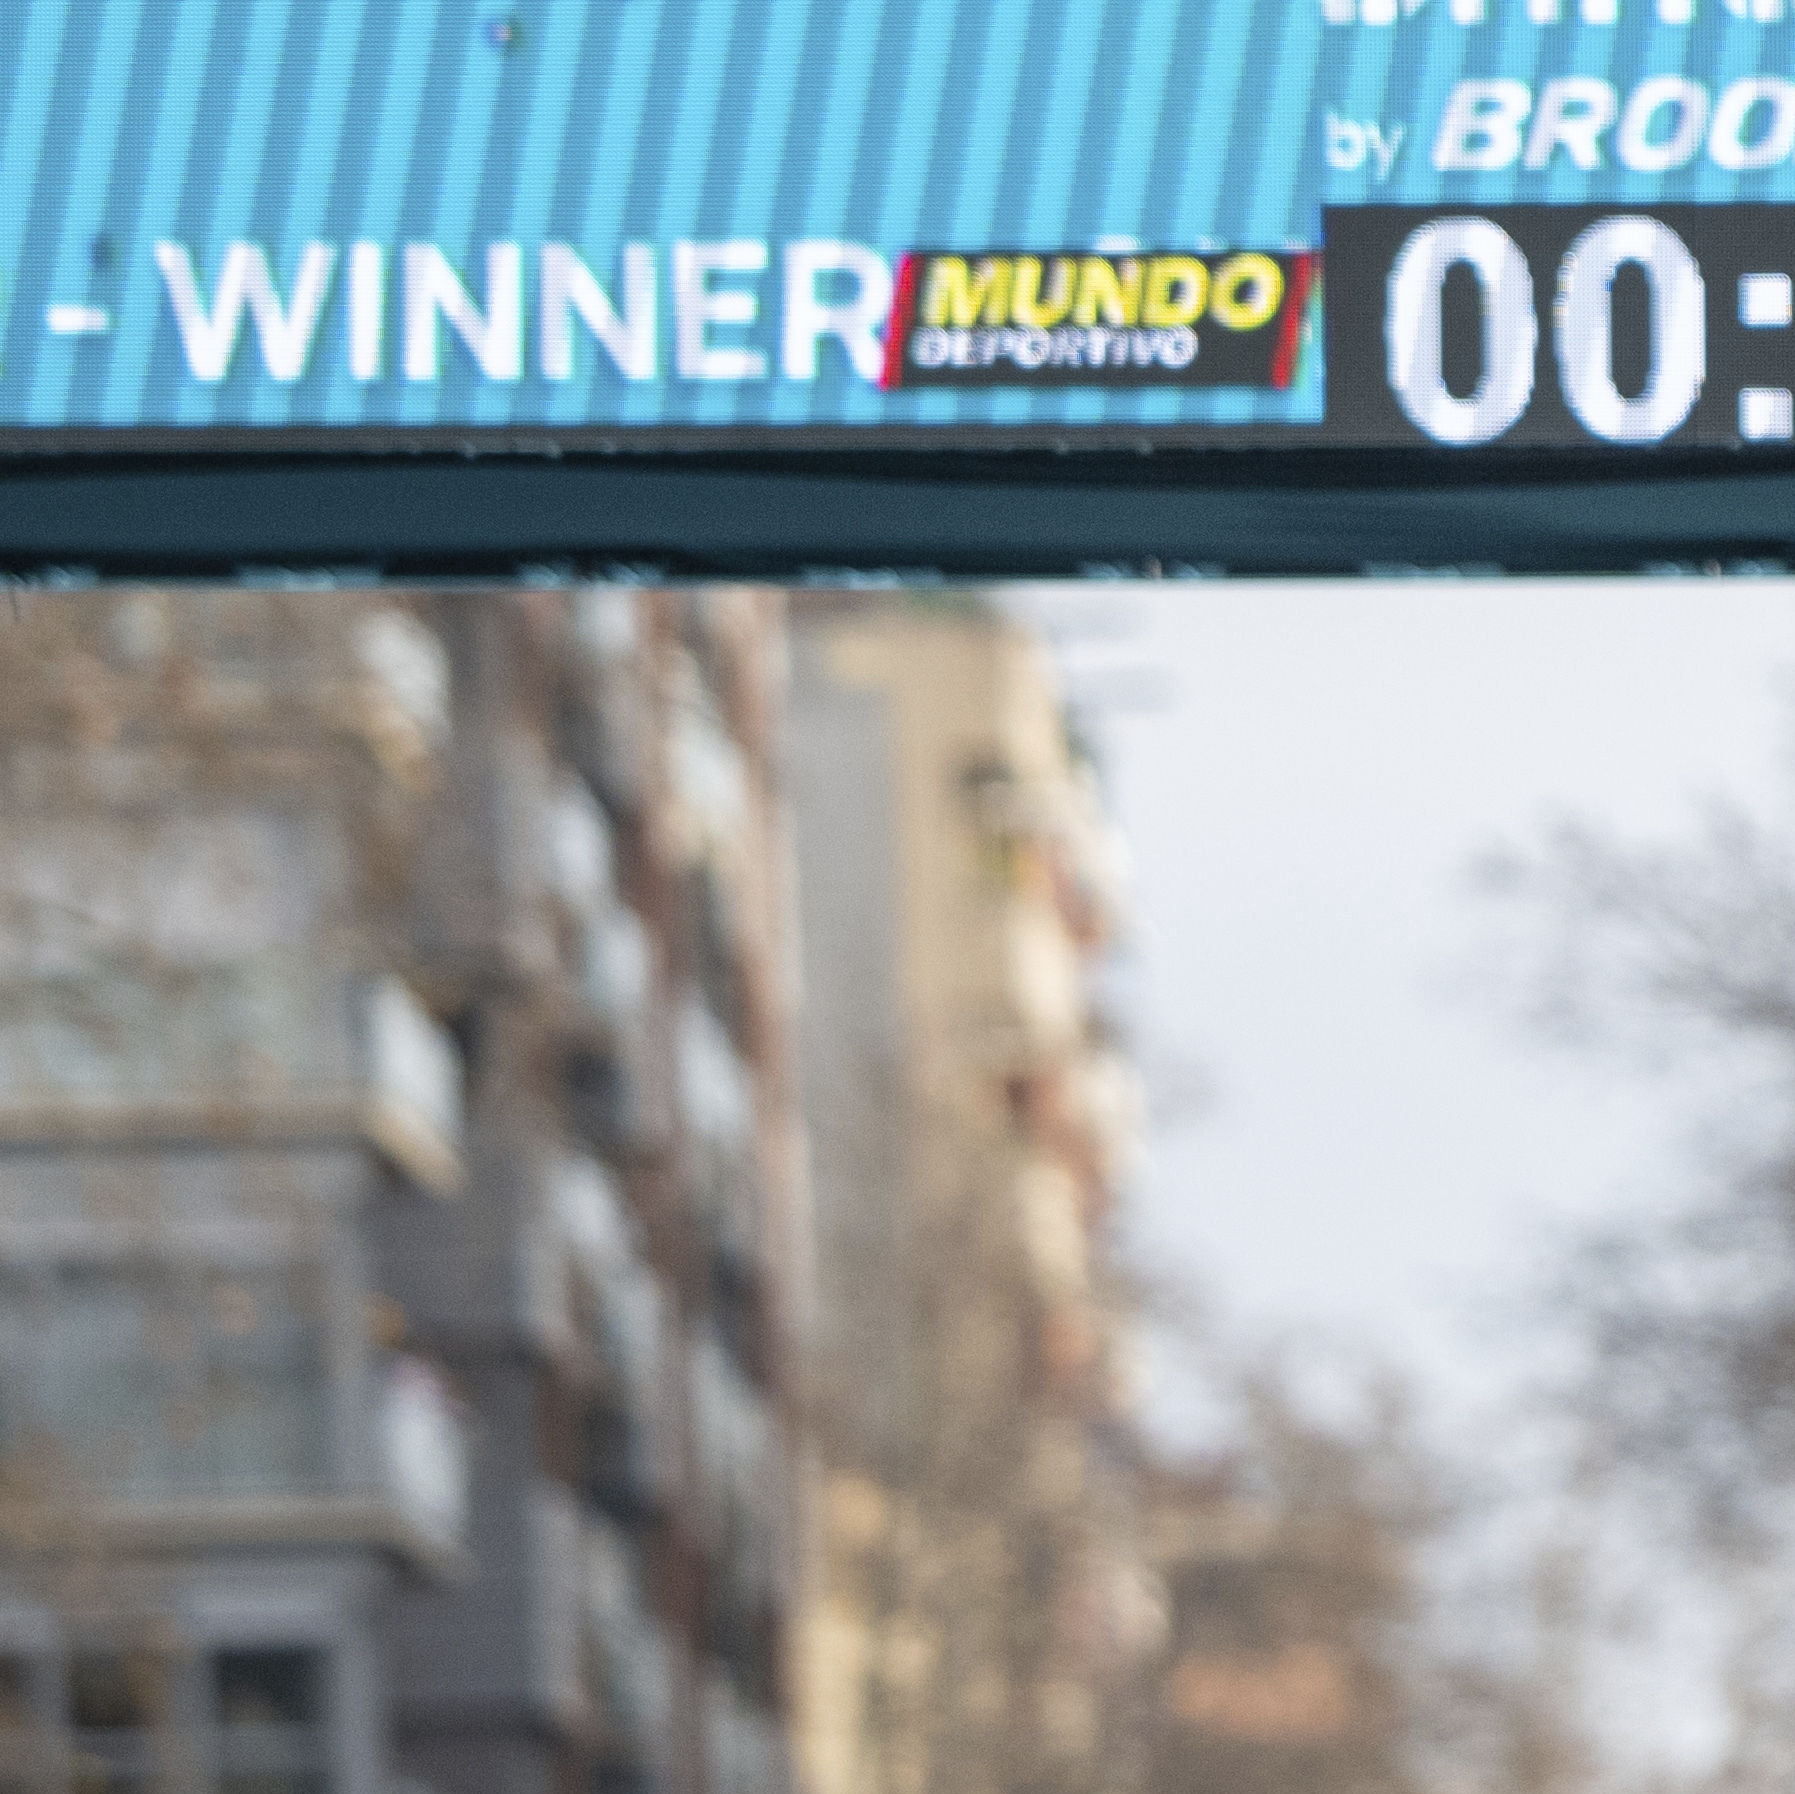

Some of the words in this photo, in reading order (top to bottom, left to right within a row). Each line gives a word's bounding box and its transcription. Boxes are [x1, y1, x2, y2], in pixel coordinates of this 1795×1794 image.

[1323, 110, 1408, 183] by
[153, 237, 890, 381] WINNER
[923, 252, 1284, 331] MUNDO
[911, 324, 1199, 369] DEPORTIVO
